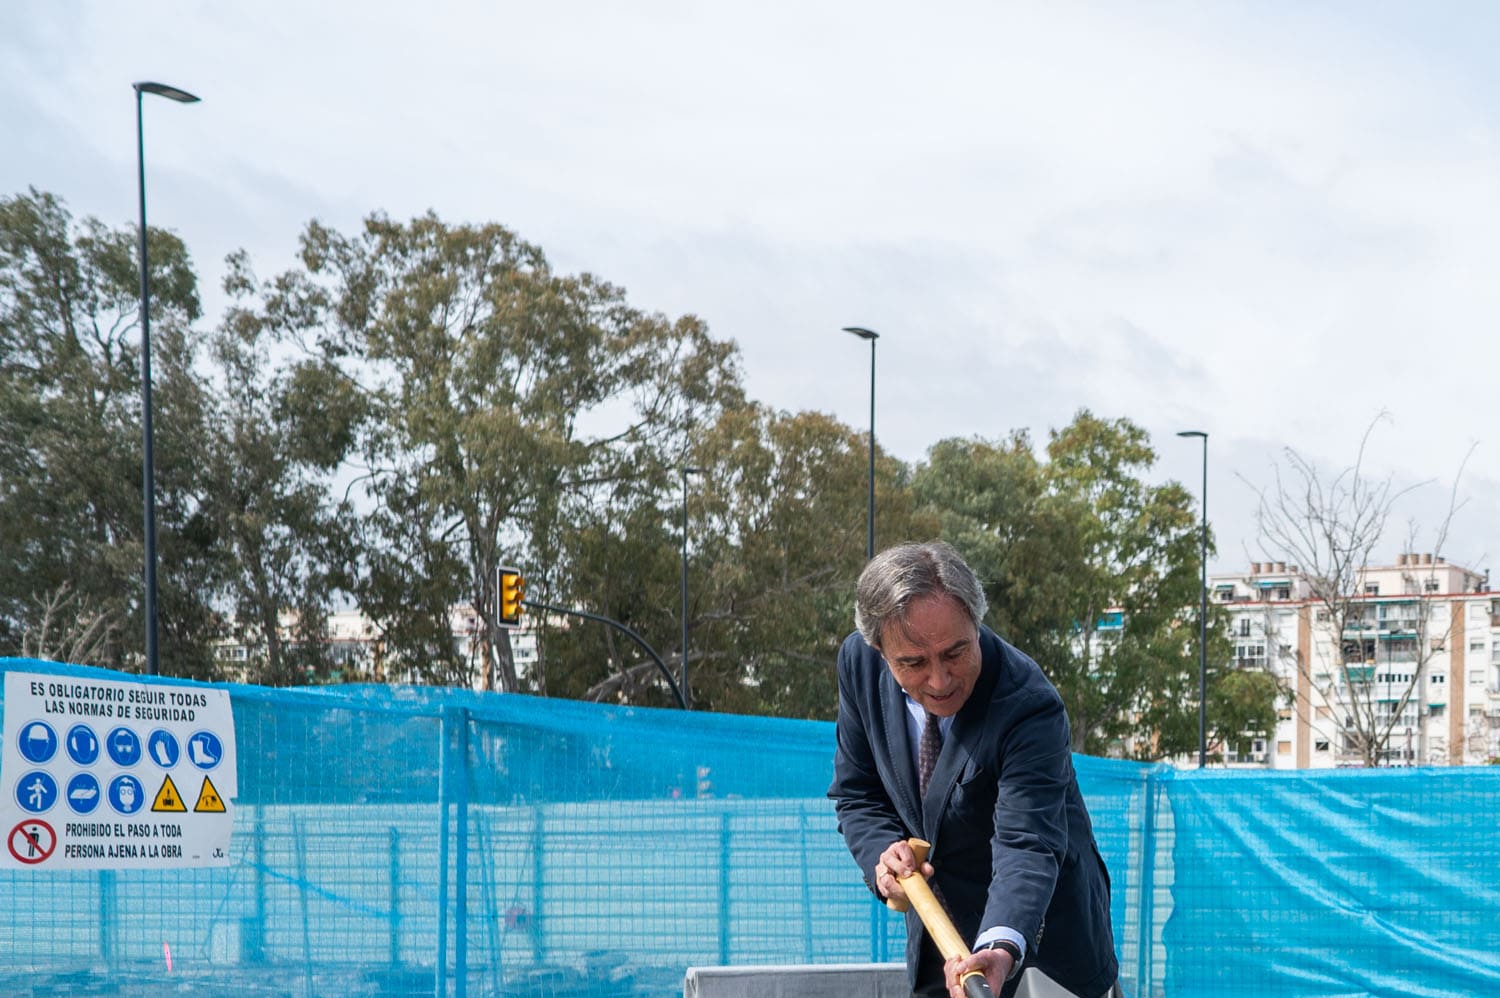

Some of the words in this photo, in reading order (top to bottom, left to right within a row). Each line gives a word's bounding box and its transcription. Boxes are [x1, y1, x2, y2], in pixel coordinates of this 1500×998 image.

[31, 682, 45, 697] ES
[49, 685, 125, 703] OBLIGATORIO
[129, 690, 166, 706] SEGUIR
[171, 693, 207, 707] TODAS
[45, 700, 65, 714] LAS
[69, 702, 113, 718] NORMAS
[117, 706, 130, 719] DE
[135, 707, 196, 722] SEGURIDAD
[65, 823, 112, 837] PROHIBIDO
[114, 824, 125, 837] EL
[128, 824, 149, 837] PASO
[152, 824, 159, 837] A
[160, 824, 183, 838] TODA
[65, 844, 106, 858] PERSONA
[108, 844, 137, 858] AJENA
[140, 845, 147, 858] A
[149, 845, 160, 858] LA
[161, 845, 183, 859] OBRA
